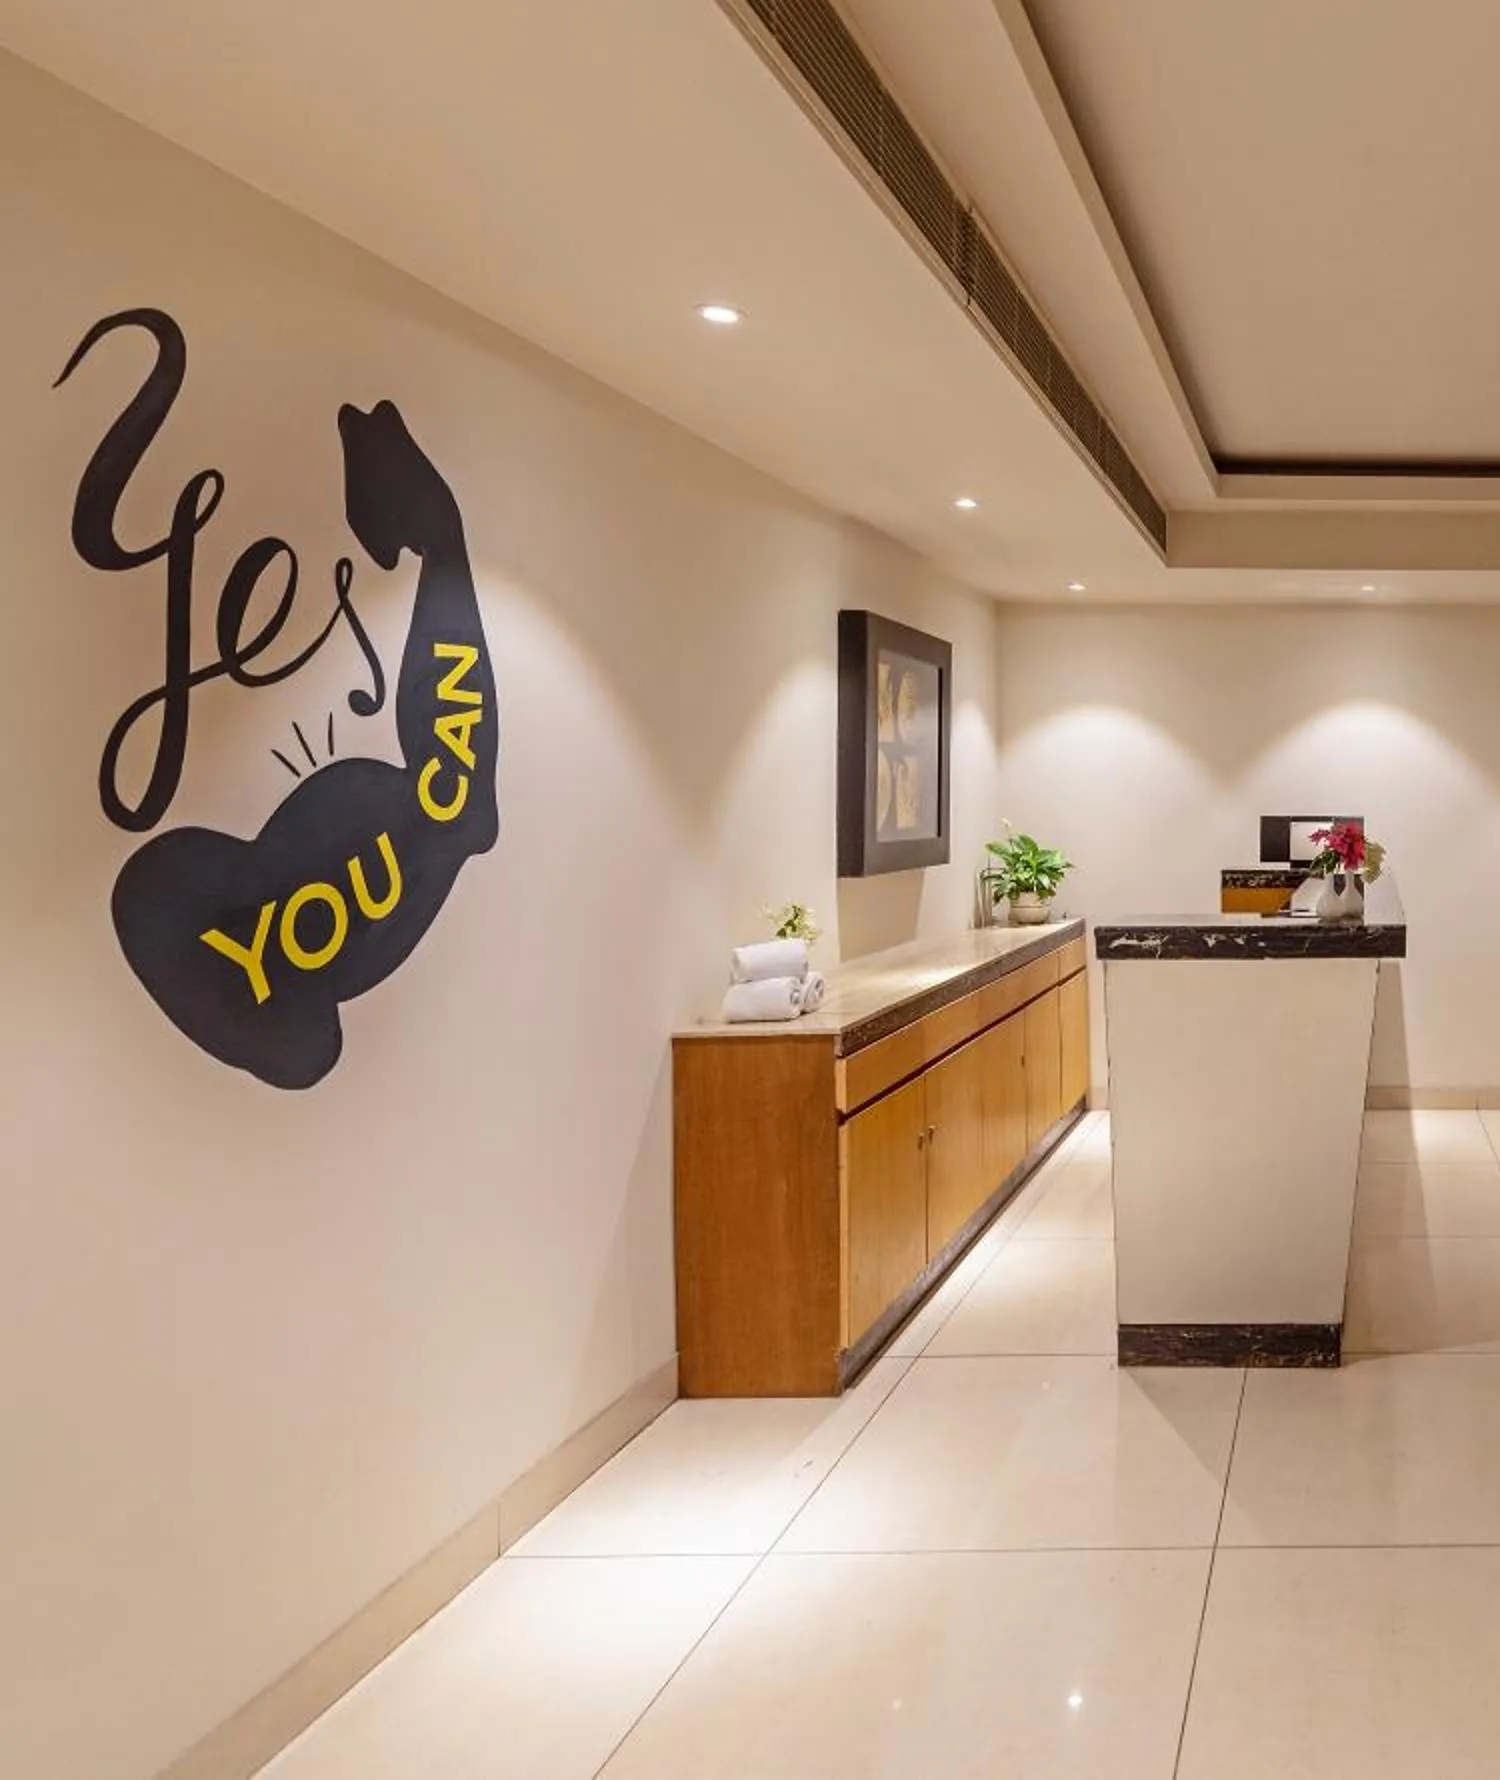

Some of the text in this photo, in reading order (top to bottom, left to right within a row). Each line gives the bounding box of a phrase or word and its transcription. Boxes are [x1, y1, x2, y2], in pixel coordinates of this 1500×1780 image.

[53, 307, 386, 832] Yes
[200, 643, 484, 1004] YOU CAN
